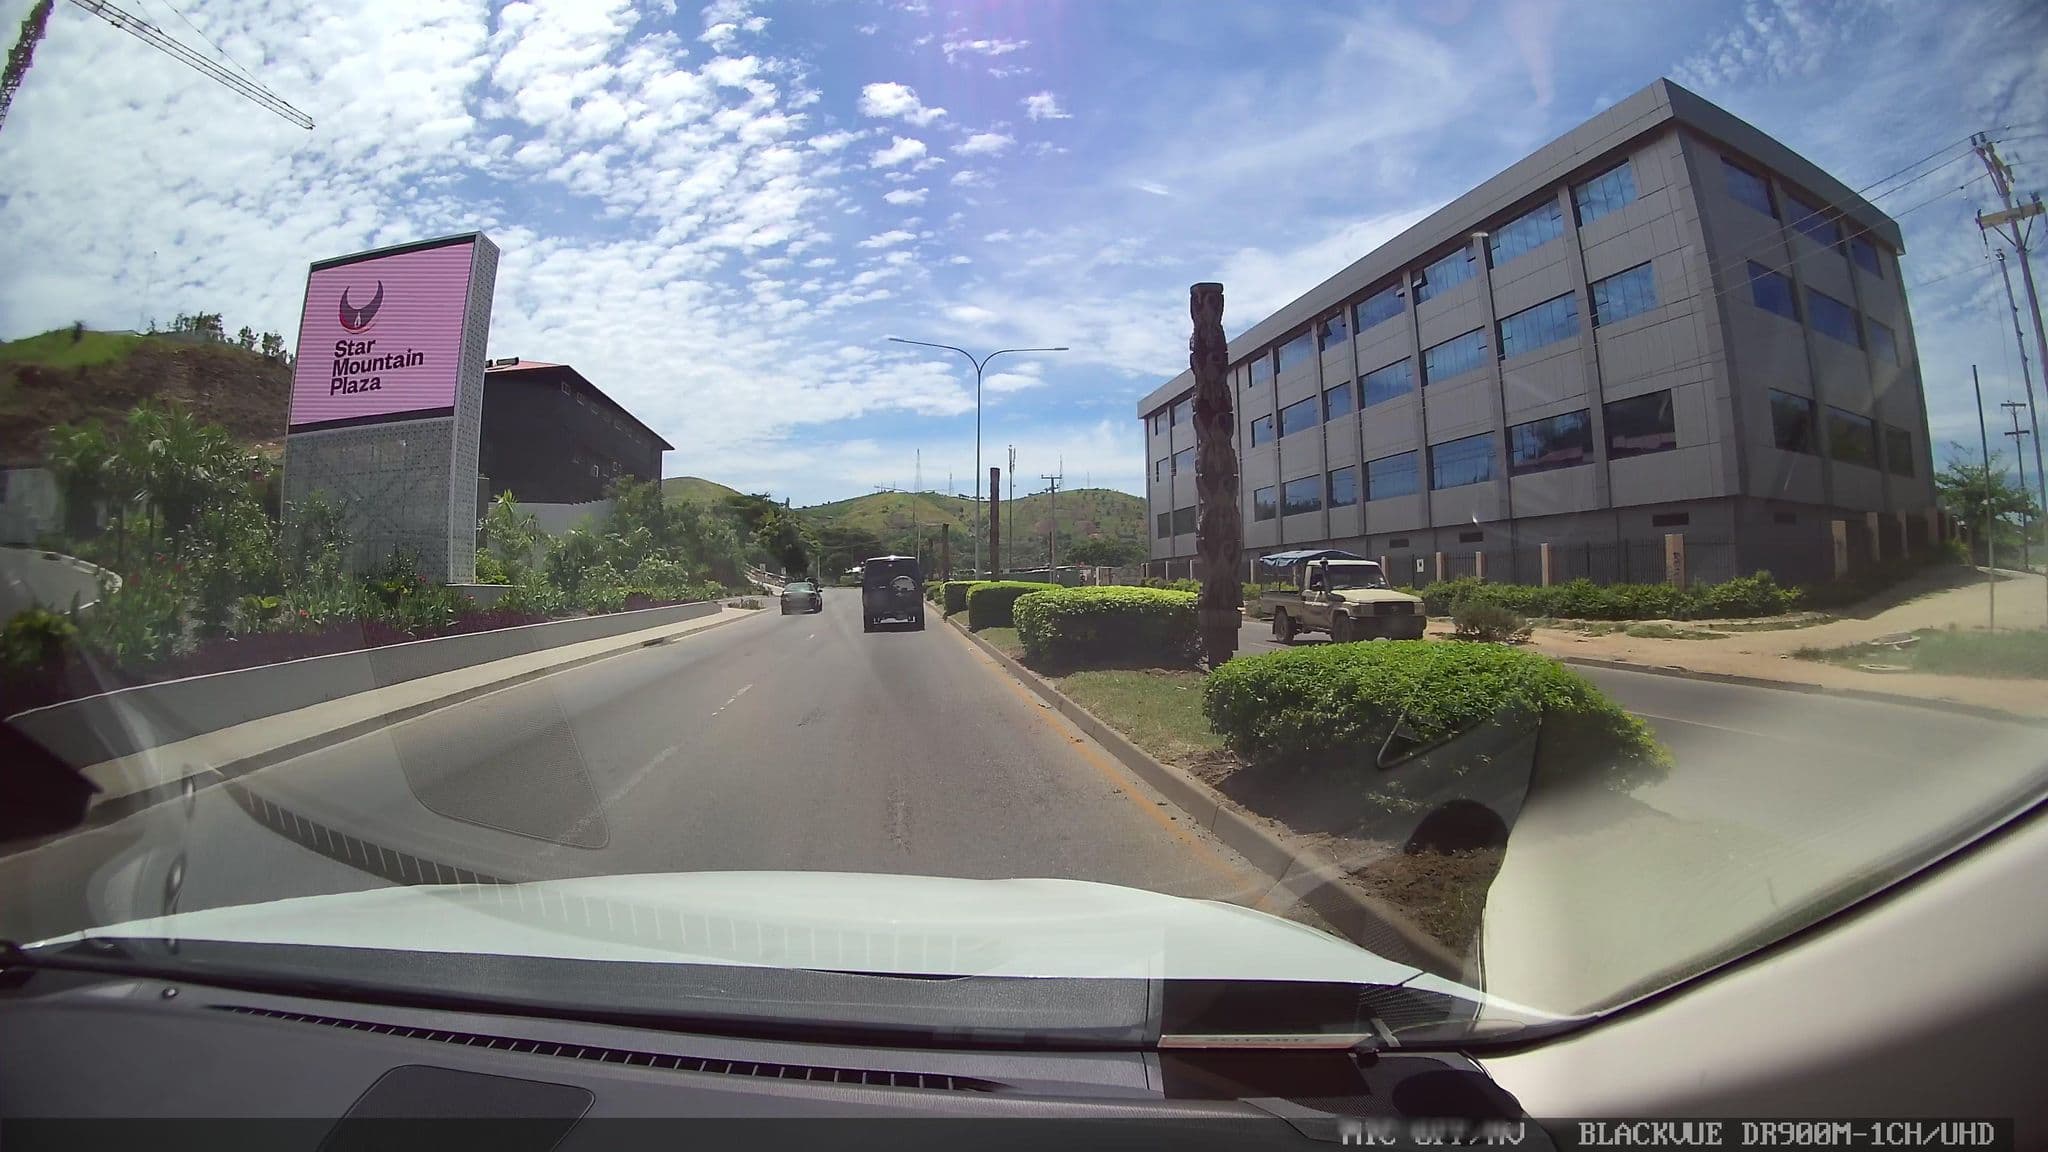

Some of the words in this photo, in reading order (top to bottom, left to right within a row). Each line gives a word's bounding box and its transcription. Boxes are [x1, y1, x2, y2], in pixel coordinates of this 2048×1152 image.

[334, 339, 376, 358] Star
[332, 348, 425, 377] Mountain
[329, 376, 382, 396] Plaza
